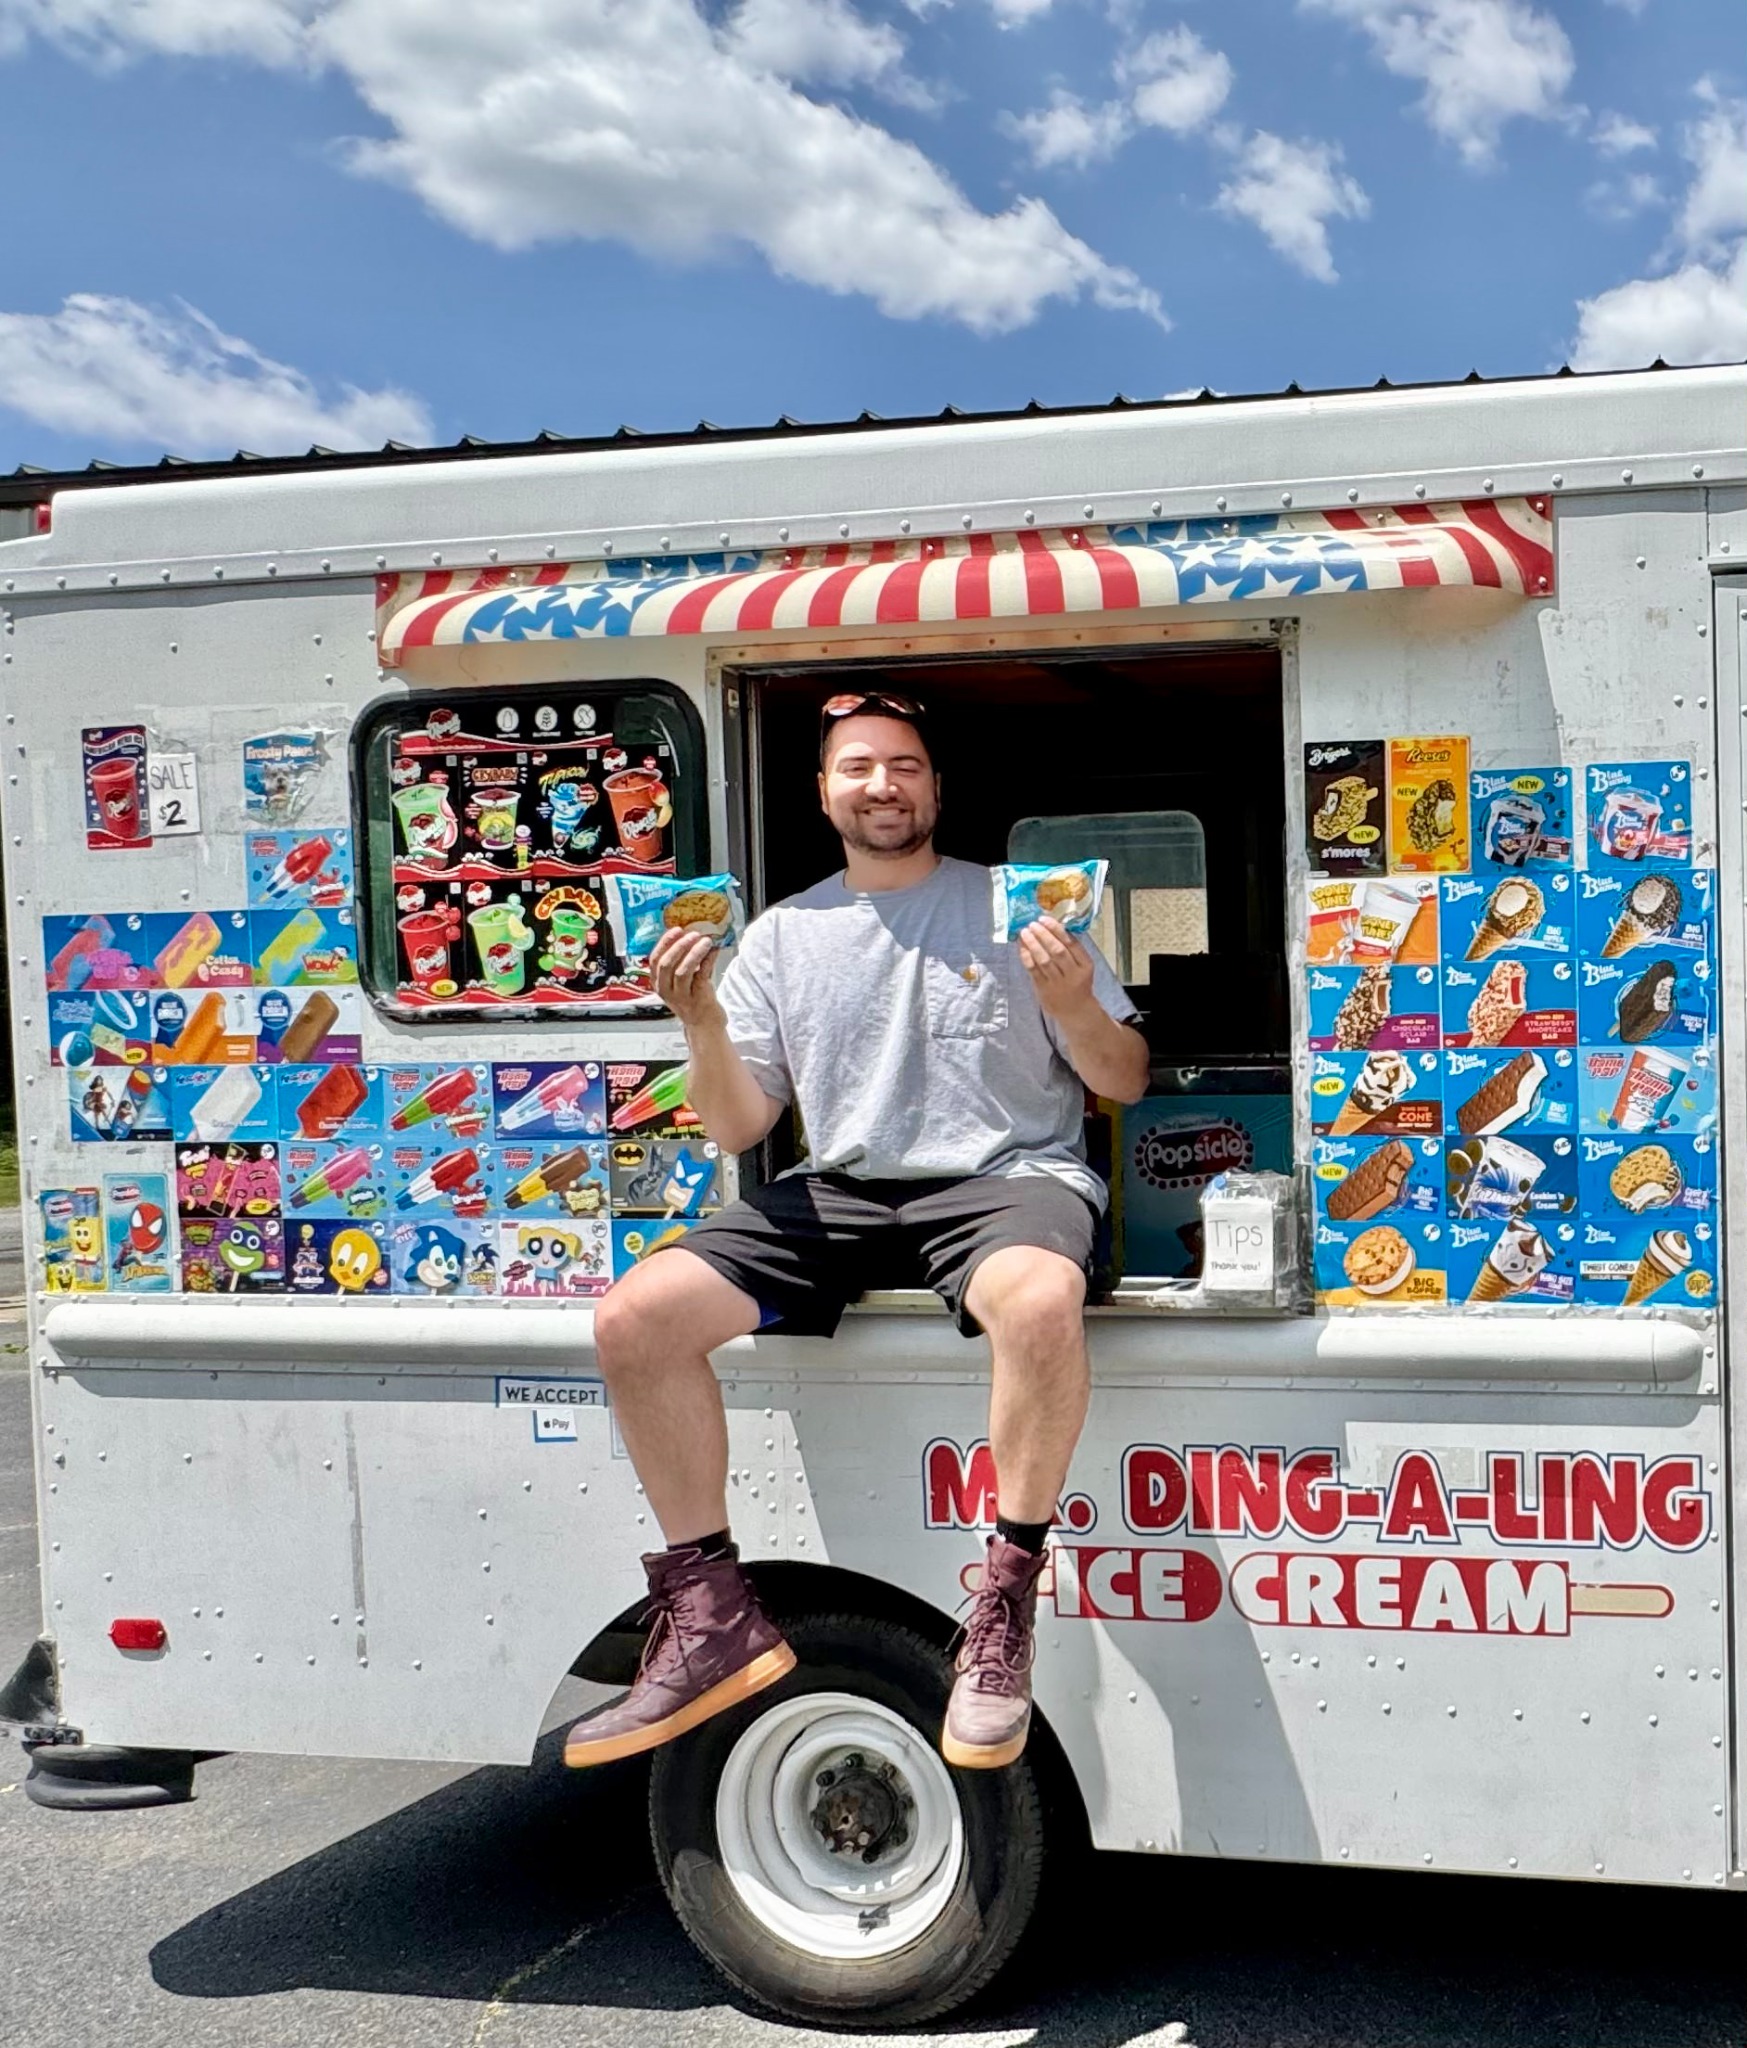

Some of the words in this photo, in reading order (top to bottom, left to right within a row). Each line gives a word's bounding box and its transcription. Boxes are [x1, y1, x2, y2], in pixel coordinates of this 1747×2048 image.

[246, 746, 282, 761] Frosty
[150, 761, 193, 790] SALE
[1517, 780, 1539, 789] NEW
[1397, 788, 1418, 797] NEW
[158, 800, 187, 826] $2
[1354, 830, 1374, 839] NEW
[1321, 846, 1371, 859] s'mores
[1308, 883, 1357, 902] LOONEY
[1316, 896, 1353, 910] TUNES
[206, 955, 240, 966] Cotton
[209, 966, 244, 978] Candy
[1319, 1082, 1339, 1091] NEW
[1398, 1112, 1433, 1122] CONE
[1147, 1133, 1243, 1169] Popsicle
[1322, 1168, 1342, 1176] NEW
[1536, 1201, 1559, 1209] Cream
[1208, 1219, 1263, 1255] Tips
[1608, 1263, 1635, 1272] CONES
[1413, 1277, 1435, 1287] BIG
[505, 1386, 530, 1401] WE
[534, 1388, 599, 1404] ACCEPT
[552, 1418, 570, 1431] Pay
[922, 1437, 1098, 1534] M.
[1121, 1443, 1712, 1556] DING-A-LING
[1057, 1550, 1188, 1623] ICE
[1230, 1552, 1568, 1635] CREAM
